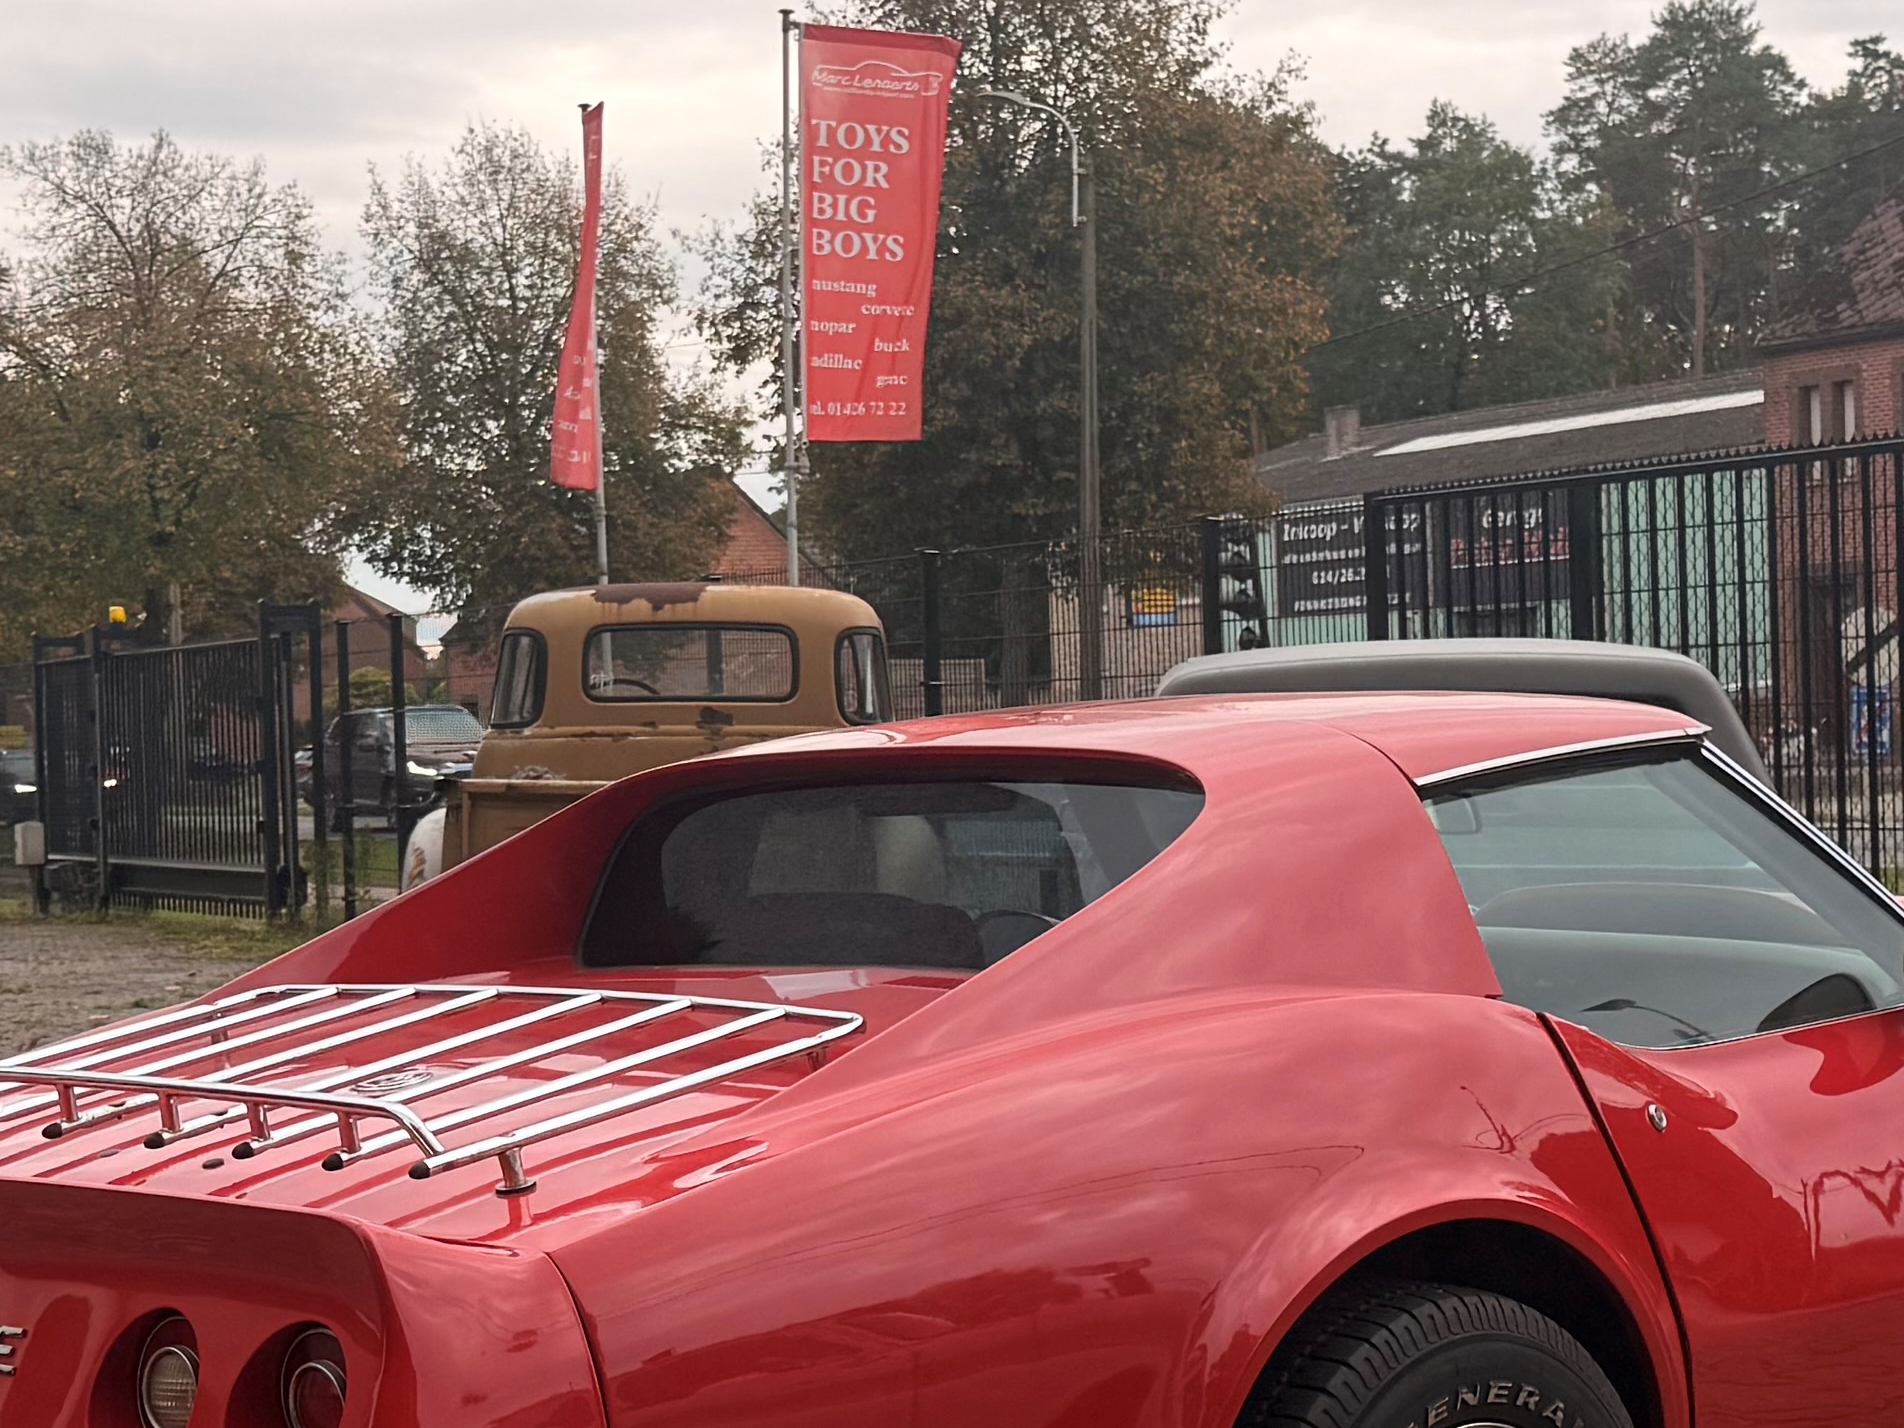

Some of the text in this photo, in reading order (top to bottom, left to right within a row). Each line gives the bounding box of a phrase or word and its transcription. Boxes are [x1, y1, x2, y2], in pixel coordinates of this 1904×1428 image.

[812, 70, 852, 86] Marc
[811, 119, 910, 154] TOYS
[812, 155, 890, 189] FOR
[812, 192, 877, 224] BIG
[812, 228, 905, 262] BOYS
